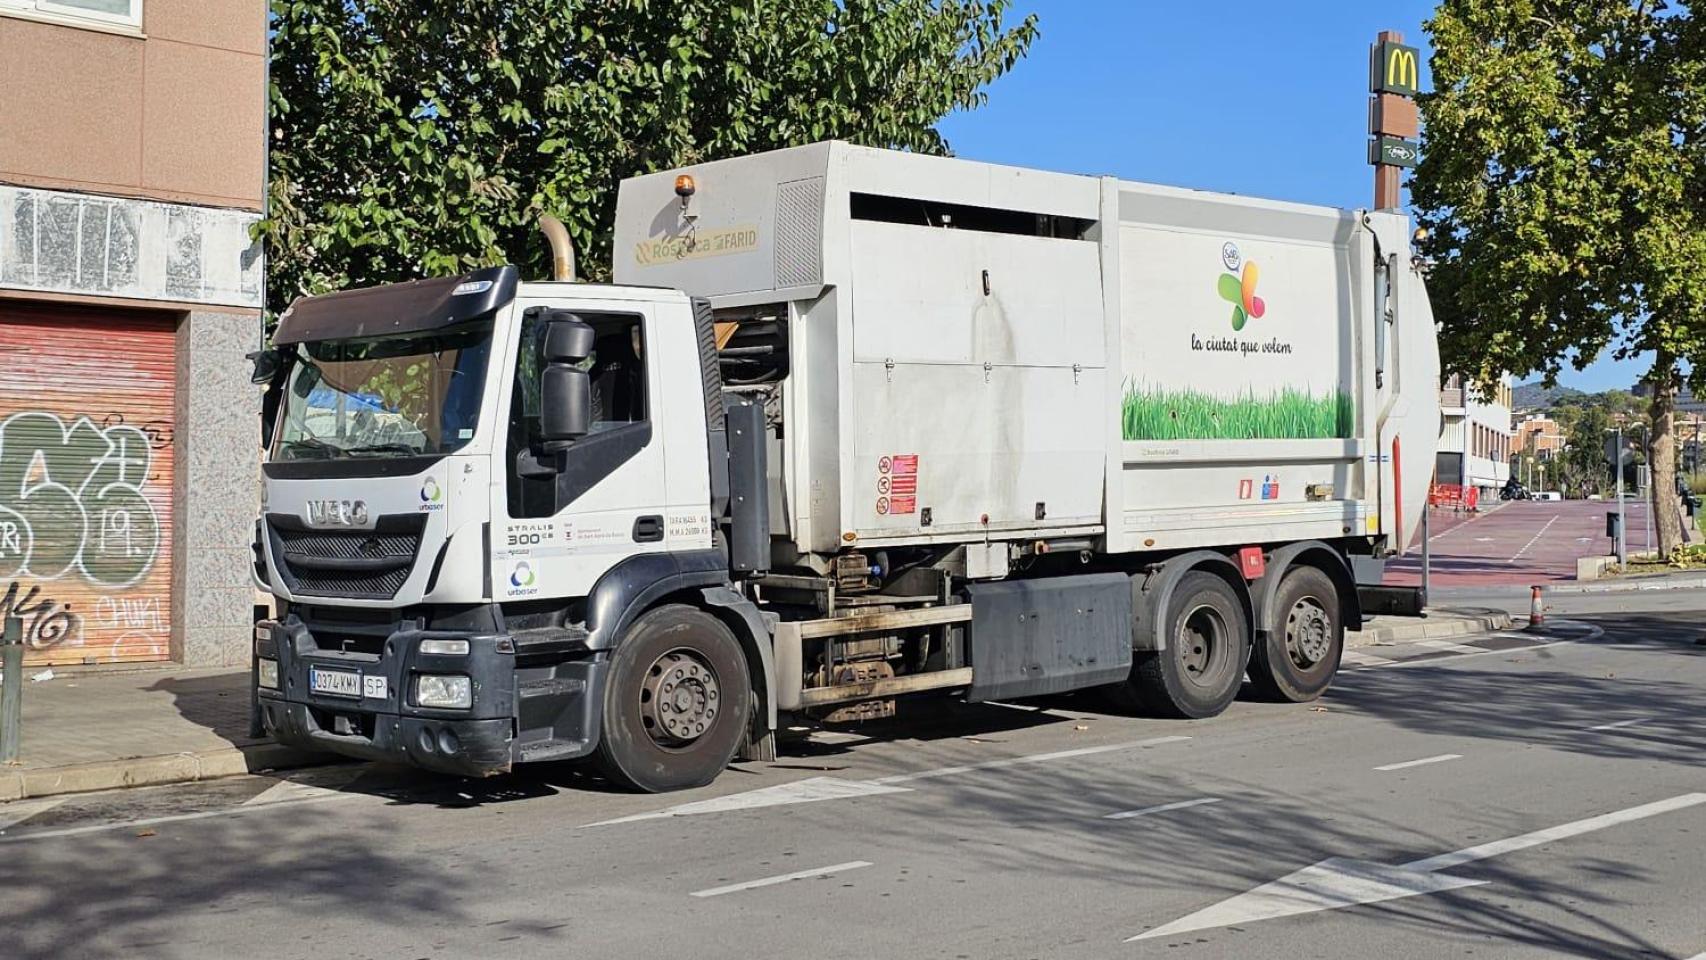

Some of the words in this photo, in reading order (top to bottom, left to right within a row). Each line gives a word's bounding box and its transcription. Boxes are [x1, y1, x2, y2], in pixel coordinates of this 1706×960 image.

[724, 231, 756, 249] FARID
[1191, 333, 1203, 351] la
[1206, 336, 1238, 352] ciutat
[1240, 341, 1260, 358] que
[1262, 337, 1292, 354] volem
[306, 500, 368, 525] IVECO
[507, 524, 554, 532] STRALIS
[507, 533, 540, 546] 300
[507, 588, 538, 596] urbaser
[316, 672, 339, 689] 0374
[366, 678, 384, 695] SP
